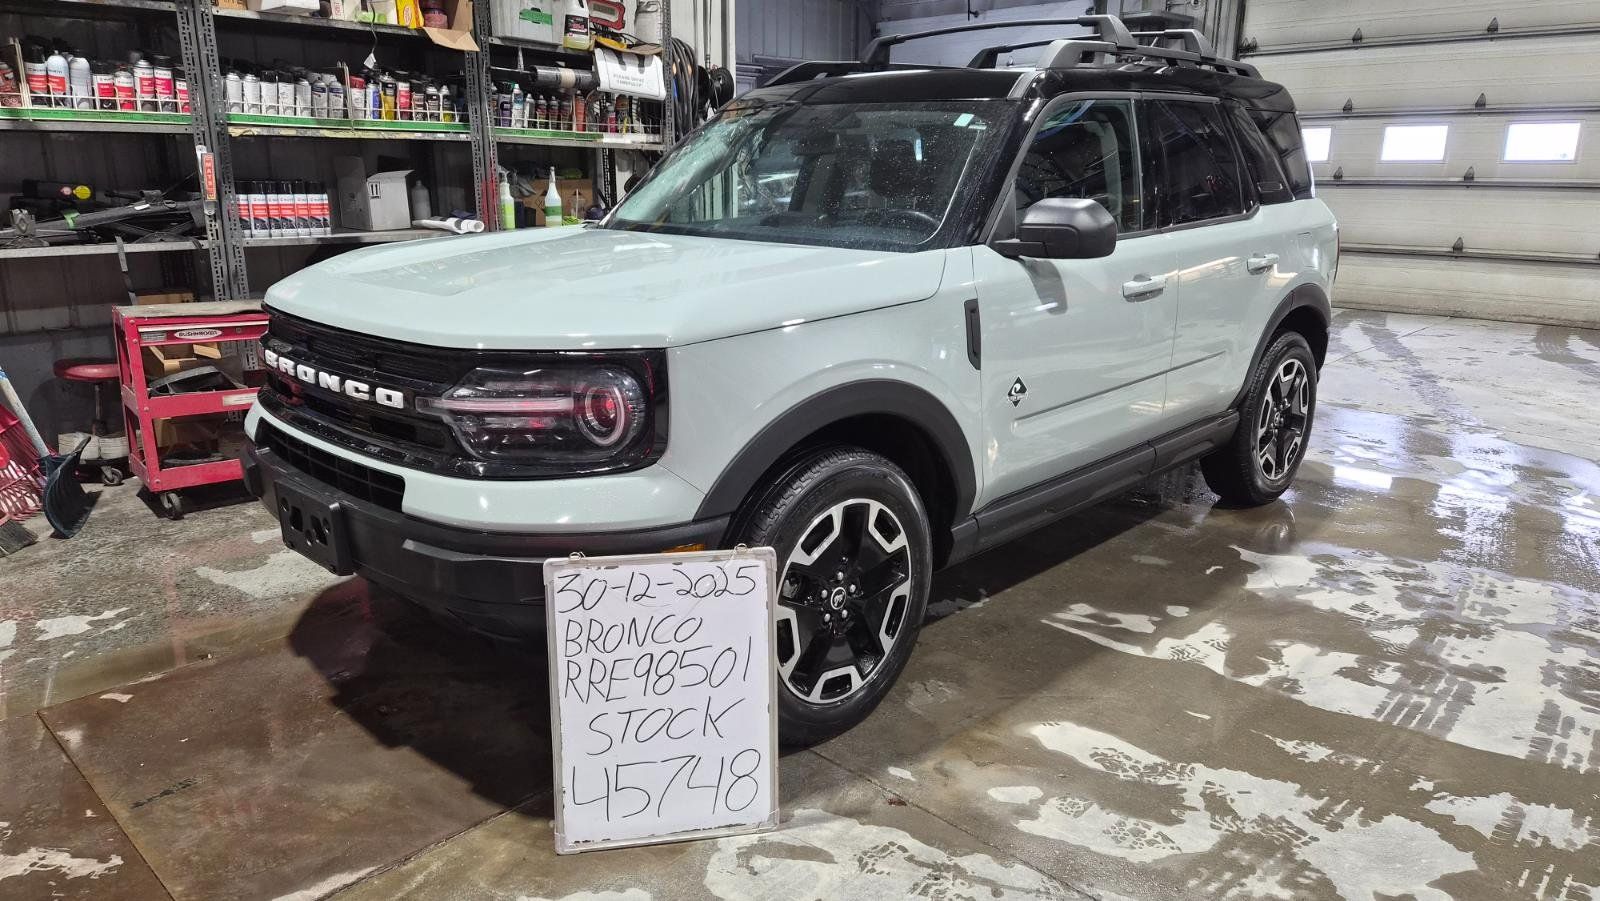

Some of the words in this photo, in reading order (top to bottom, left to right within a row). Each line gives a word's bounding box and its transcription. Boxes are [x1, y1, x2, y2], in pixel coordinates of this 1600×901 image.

[264, 349, 404, 409] BRONCO
[556, 564, 760, 613] 30-12-2025
[564, 614, 704, 658] BRONCO
[564, 635, 752, 704] RRE98501
[586, 695, 746, 756] STOCK
[572, 748, 761, 822] 45748
